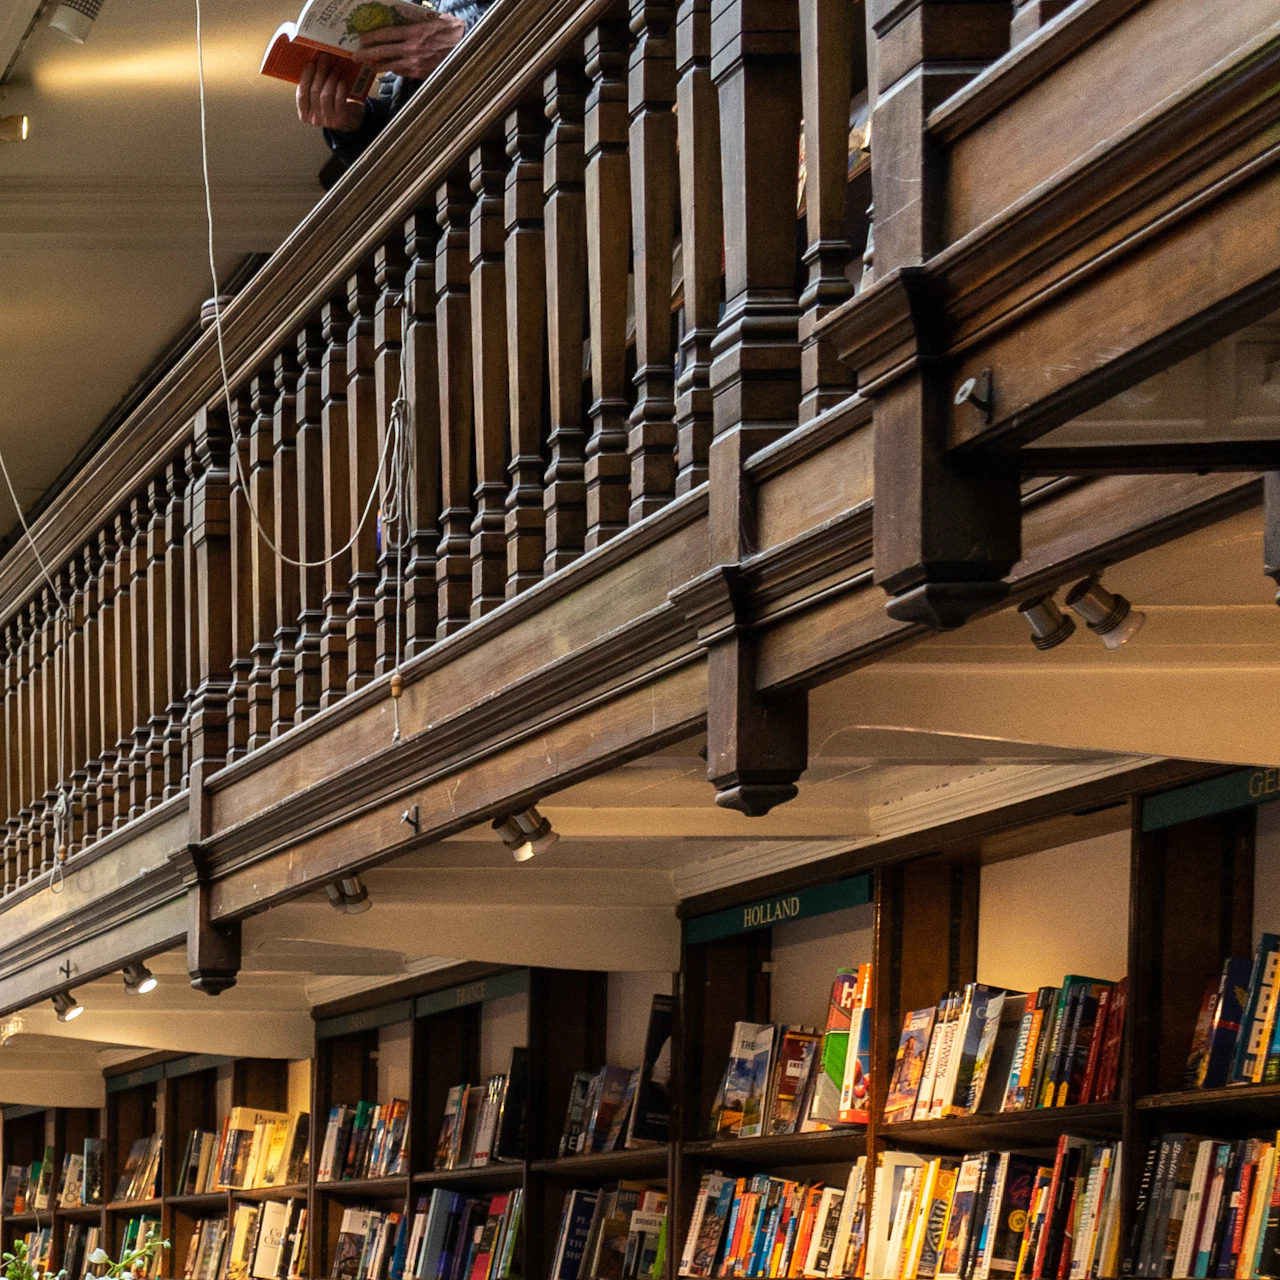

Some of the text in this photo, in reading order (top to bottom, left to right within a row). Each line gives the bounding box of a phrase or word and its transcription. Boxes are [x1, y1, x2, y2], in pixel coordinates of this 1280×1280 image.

[743, 897, 800, 928] HOLLAND
[924, 1026, 942, 1079] Germany
[941, 1023, 961, 1077] Germany
[1012, 1014, 1033, 1077] GERMANY
[1022, 1015, 1041, 1069] GERMANY
